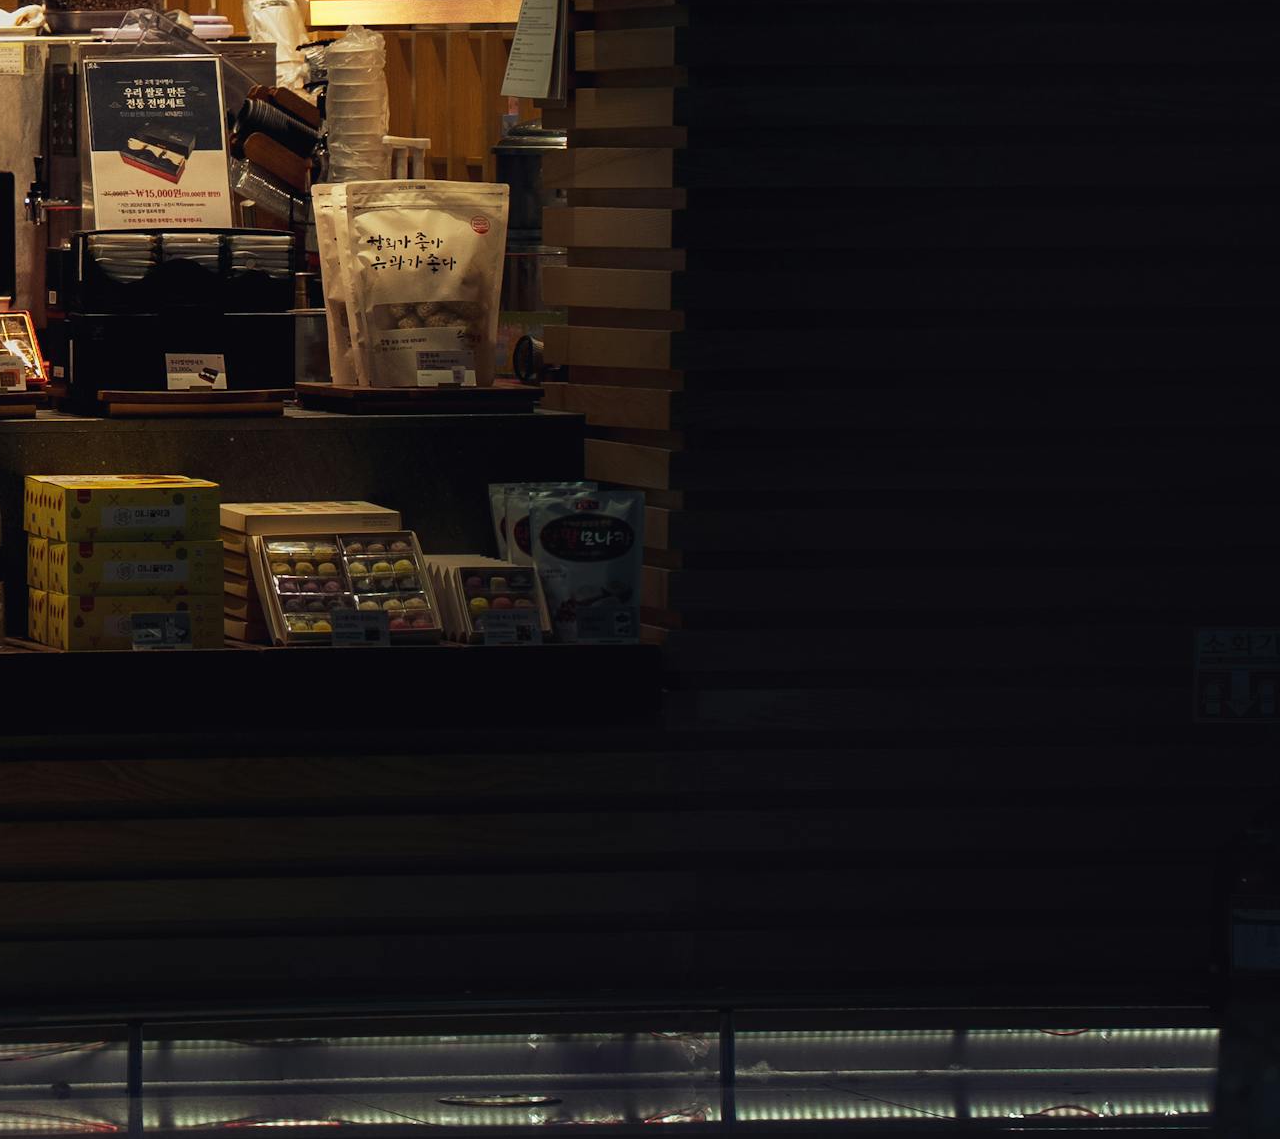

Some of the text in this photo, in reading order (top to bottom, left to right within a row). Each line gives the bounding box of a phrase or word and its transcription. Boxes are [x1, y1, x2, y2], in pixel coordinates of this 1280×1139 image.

[123, 87, 142, 98] 우리
[167, 87, 186, 98] 만든
[126, 98, 186, 110] 전통 전병세트
